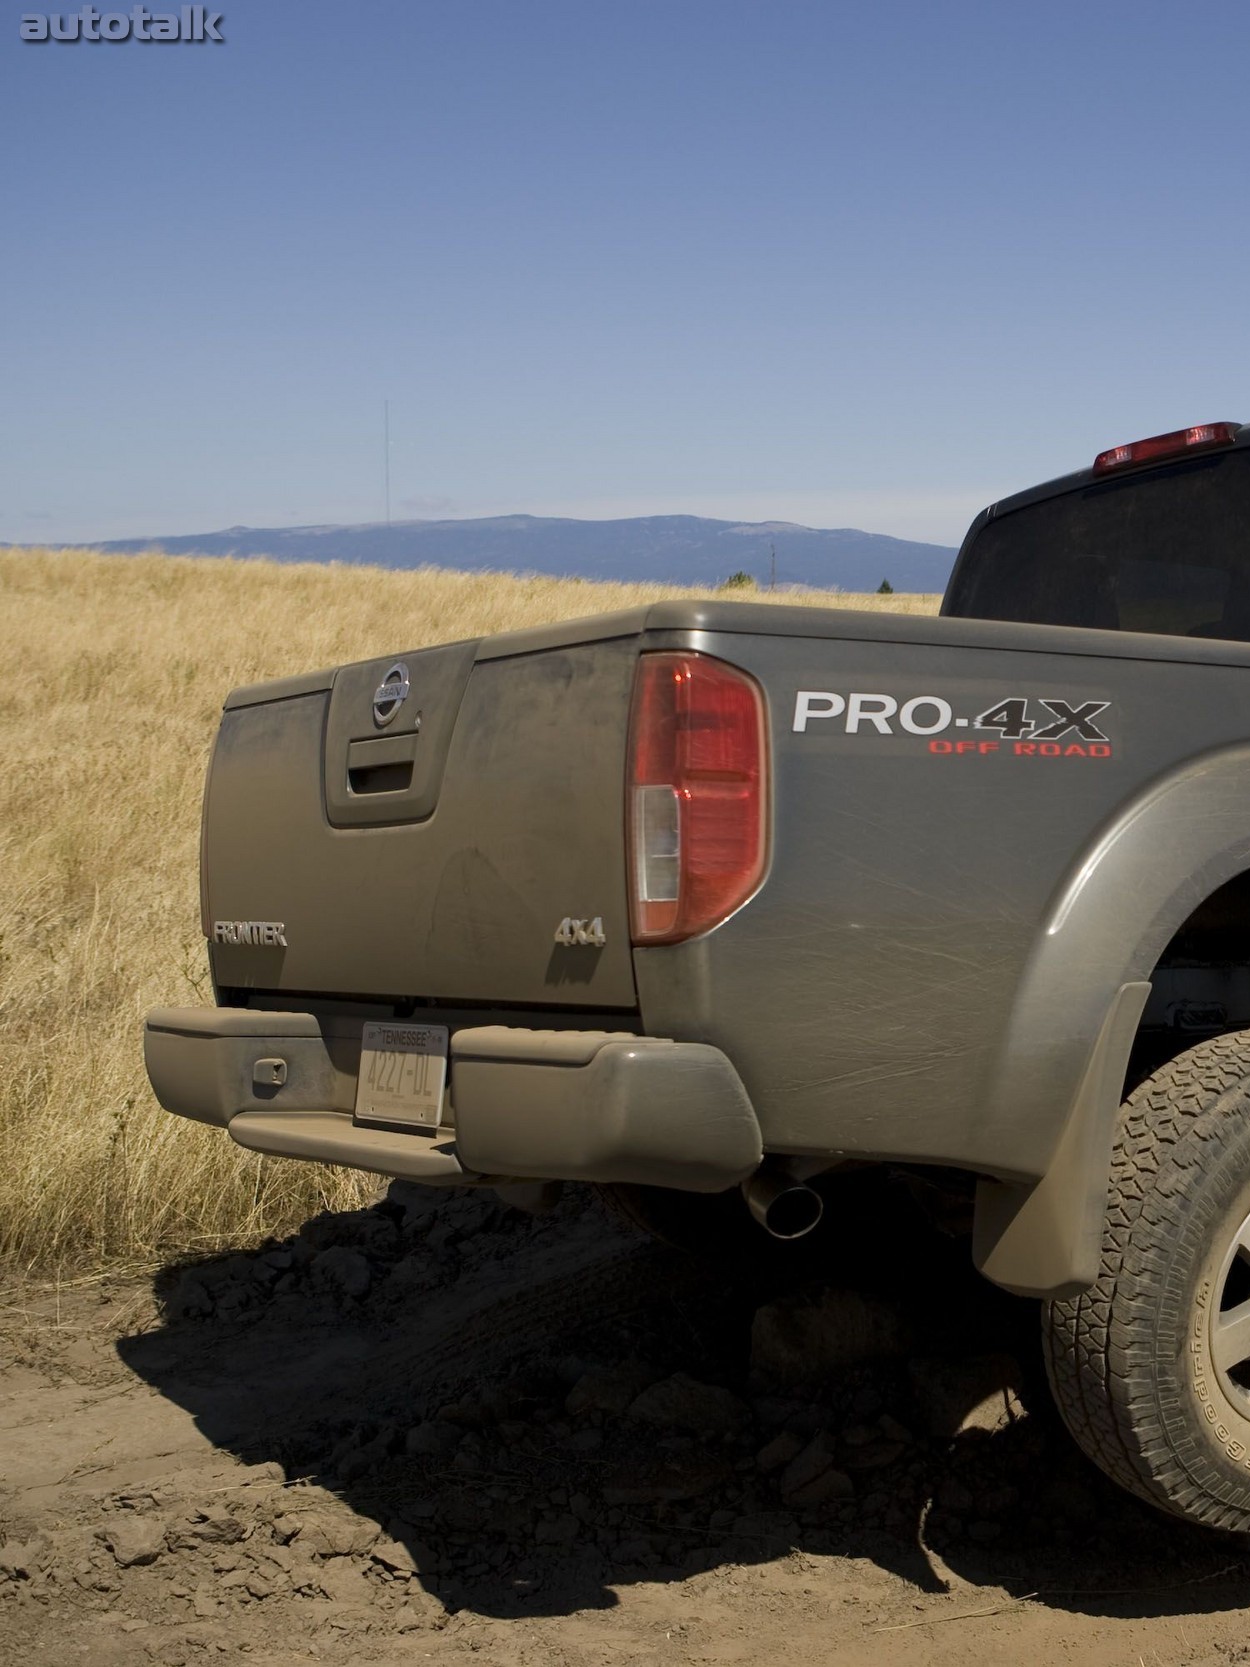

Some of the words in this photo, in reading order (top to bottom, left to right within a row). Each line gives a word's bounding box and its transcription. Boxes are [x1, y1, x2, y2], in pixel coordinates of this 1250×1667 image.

[792, 690, 1112, 742] PRO-4X
[928, 740, 1000, 755] OFF
[1013, 742, 1112, 758] ROAD
[214, 920, 288, 947] FRONTIER
[381, 1029, 427, 1047] TENNESSEE
